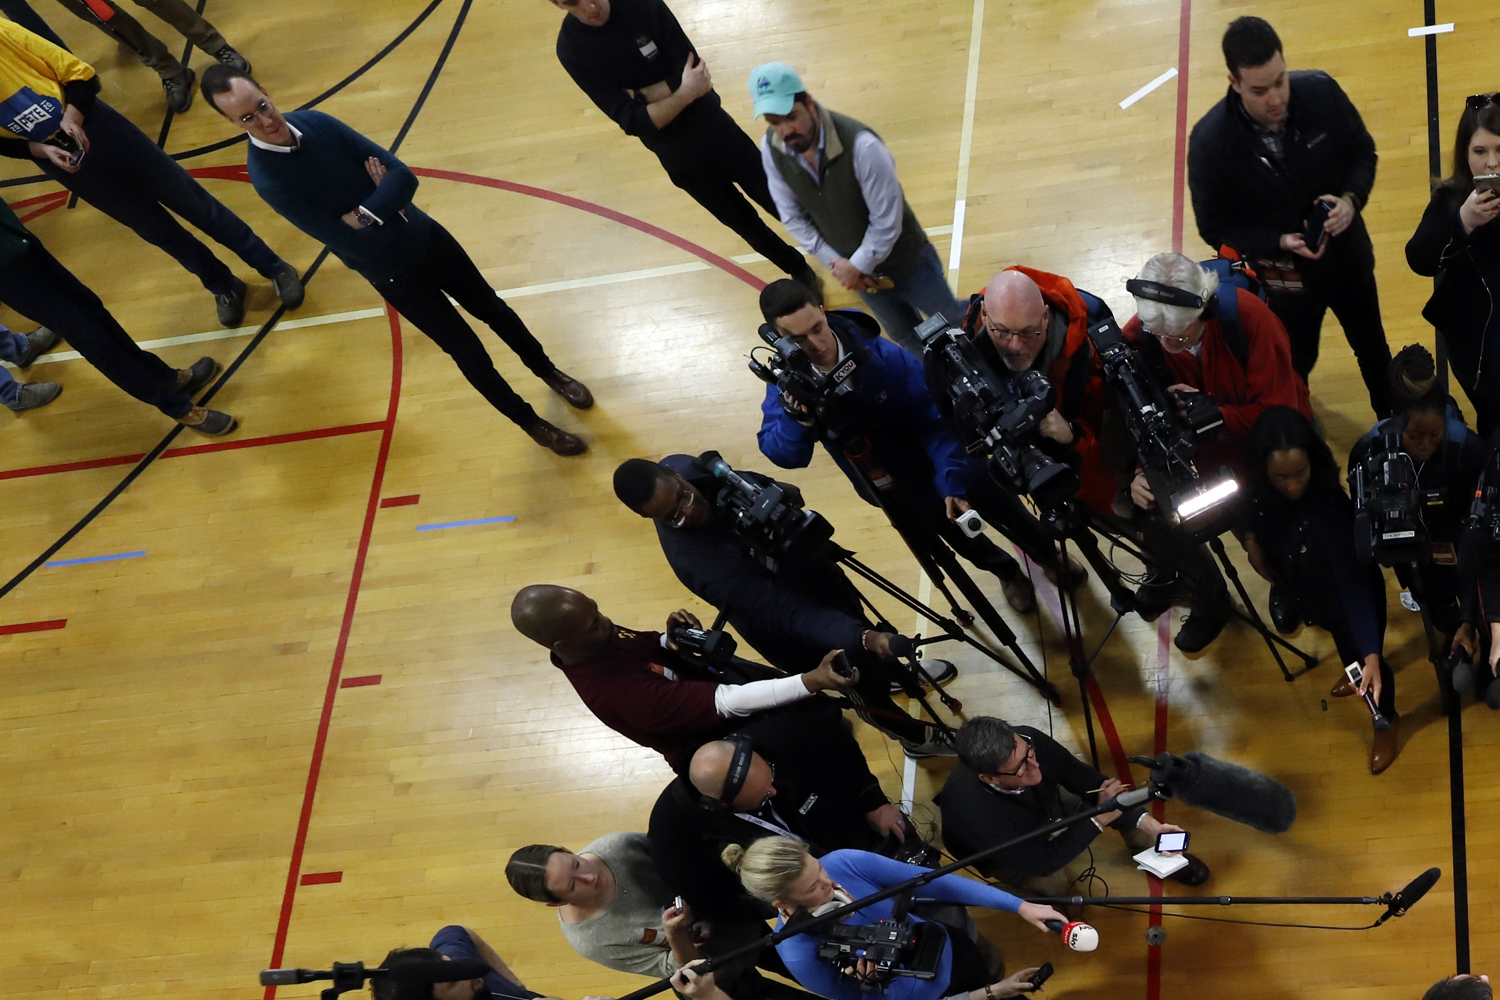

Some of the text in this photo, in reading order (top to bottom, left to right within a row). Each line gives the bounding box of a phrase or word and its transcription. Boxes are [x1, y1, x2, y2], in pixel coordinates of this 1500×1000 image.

[17, 106, 48, 129] PETE
[834, 361, 854, 381] KYOU
[1070, 933, 1078, 948] sky
